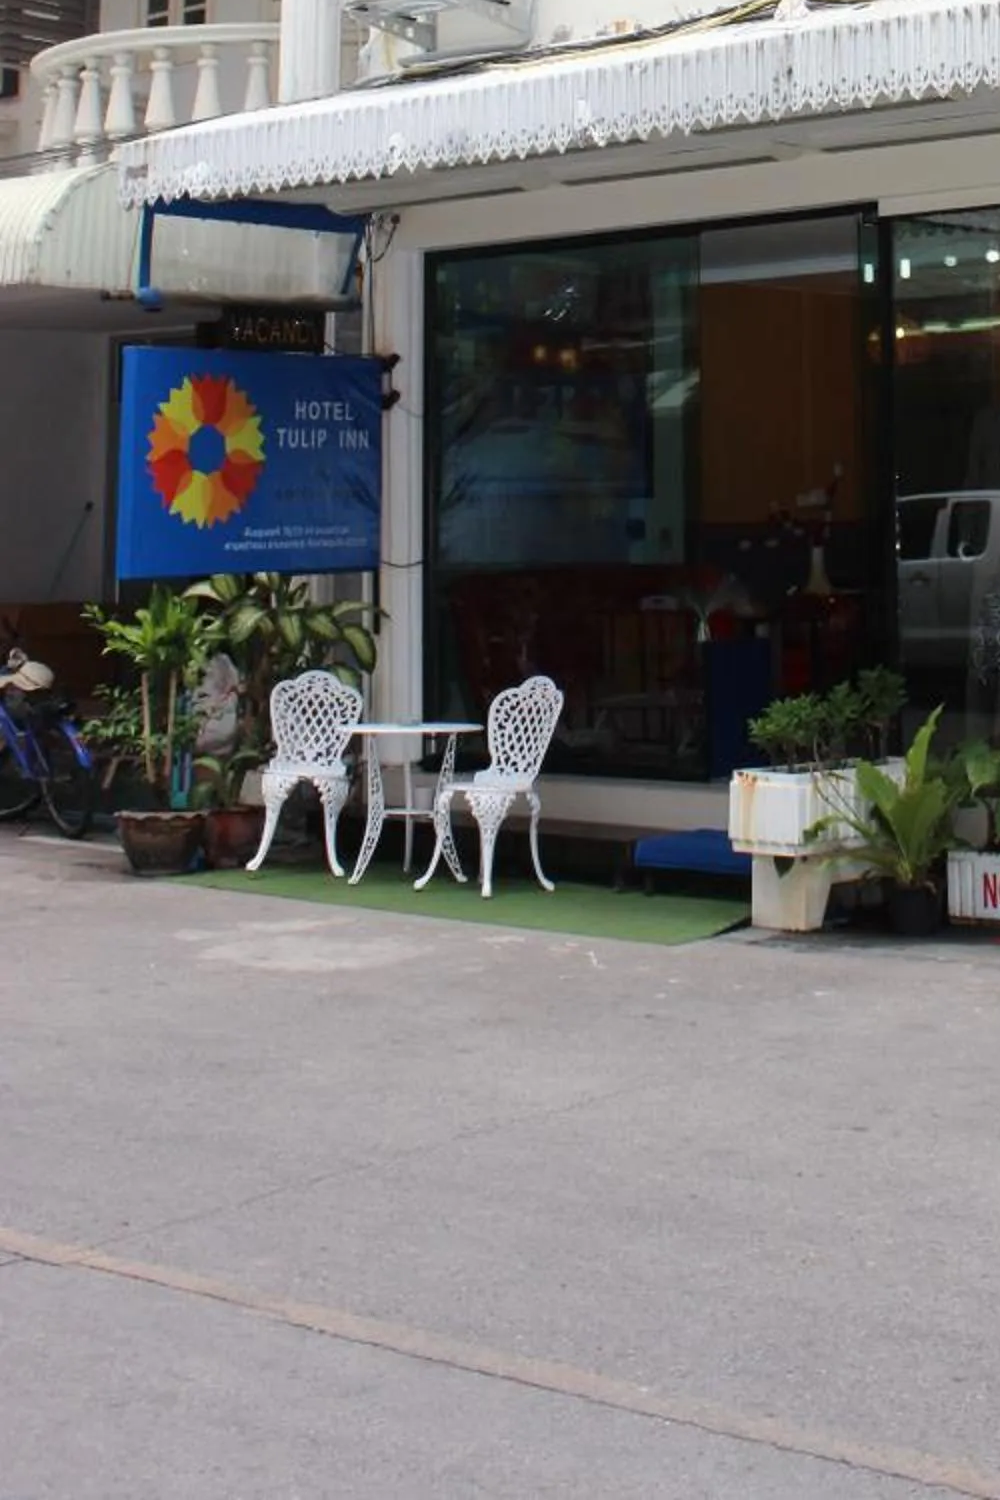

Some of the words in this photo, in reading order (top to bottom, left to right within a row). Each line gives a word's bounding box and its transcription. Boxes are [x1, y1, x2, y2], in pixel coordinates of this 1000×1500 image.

[294, 399, 354, 421] HOTEL
[276, 428, 327, 449] TULIP
[338, 429, 370, 449] INN
